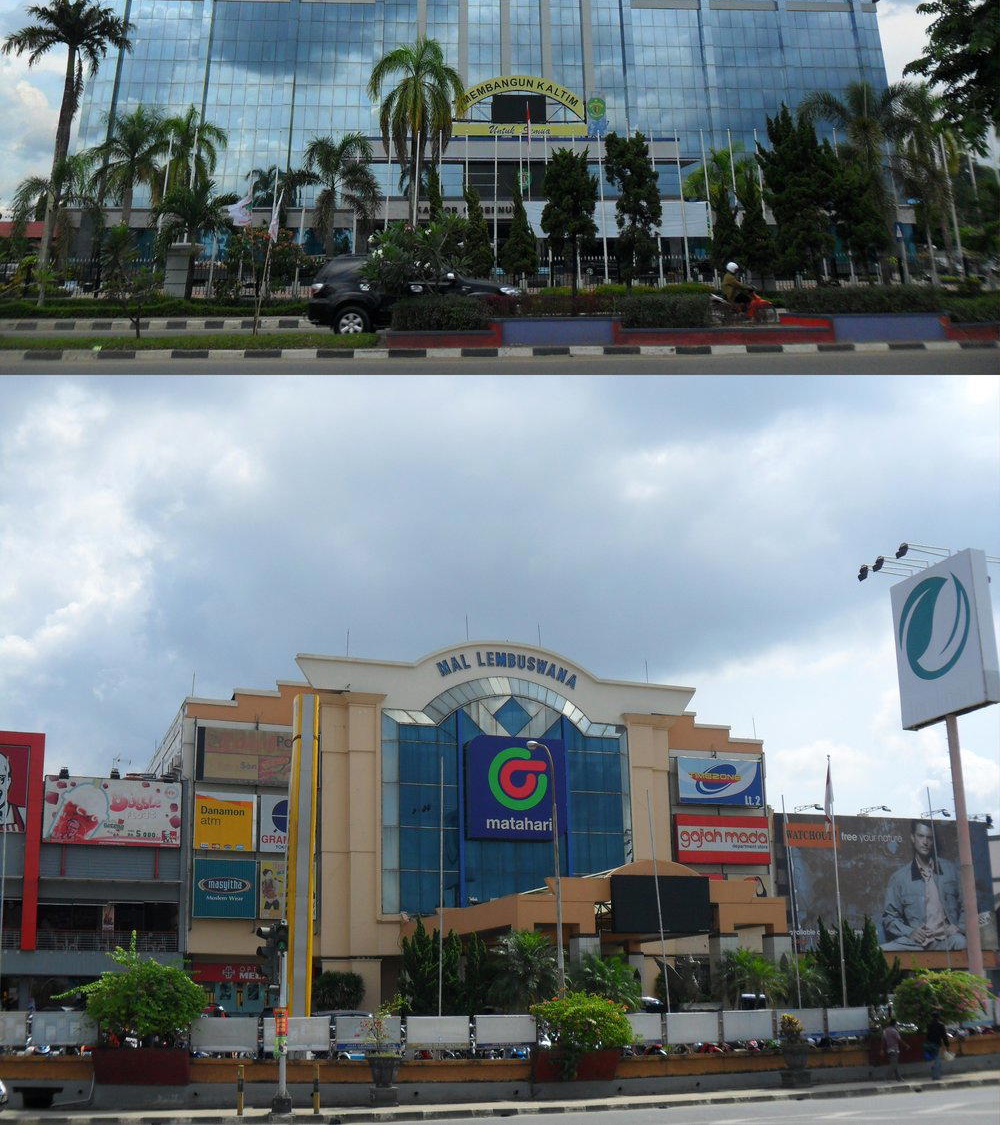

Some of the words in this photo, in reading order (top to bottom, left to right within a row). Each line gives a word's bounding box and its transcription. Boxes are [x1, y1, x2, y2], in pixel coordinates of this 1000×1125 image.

[463, 78, 534, 105] MEMBANGUN
[536, 81, 579, 107] KALTIM
[488, 125, 516, 135] Untuk
[436, 654, 471, 677] MAL
[476, 651, 577, 690] LEMBUSWANA
[200, 805, 245, 816] Danamon
[200, 816, 221, 826] atm
[486, 817, 553, 831] matahari
[680, 829, 723, 849] gajah
[724, 831, 768, 844] mada
[841, 831, 858, 841] free
